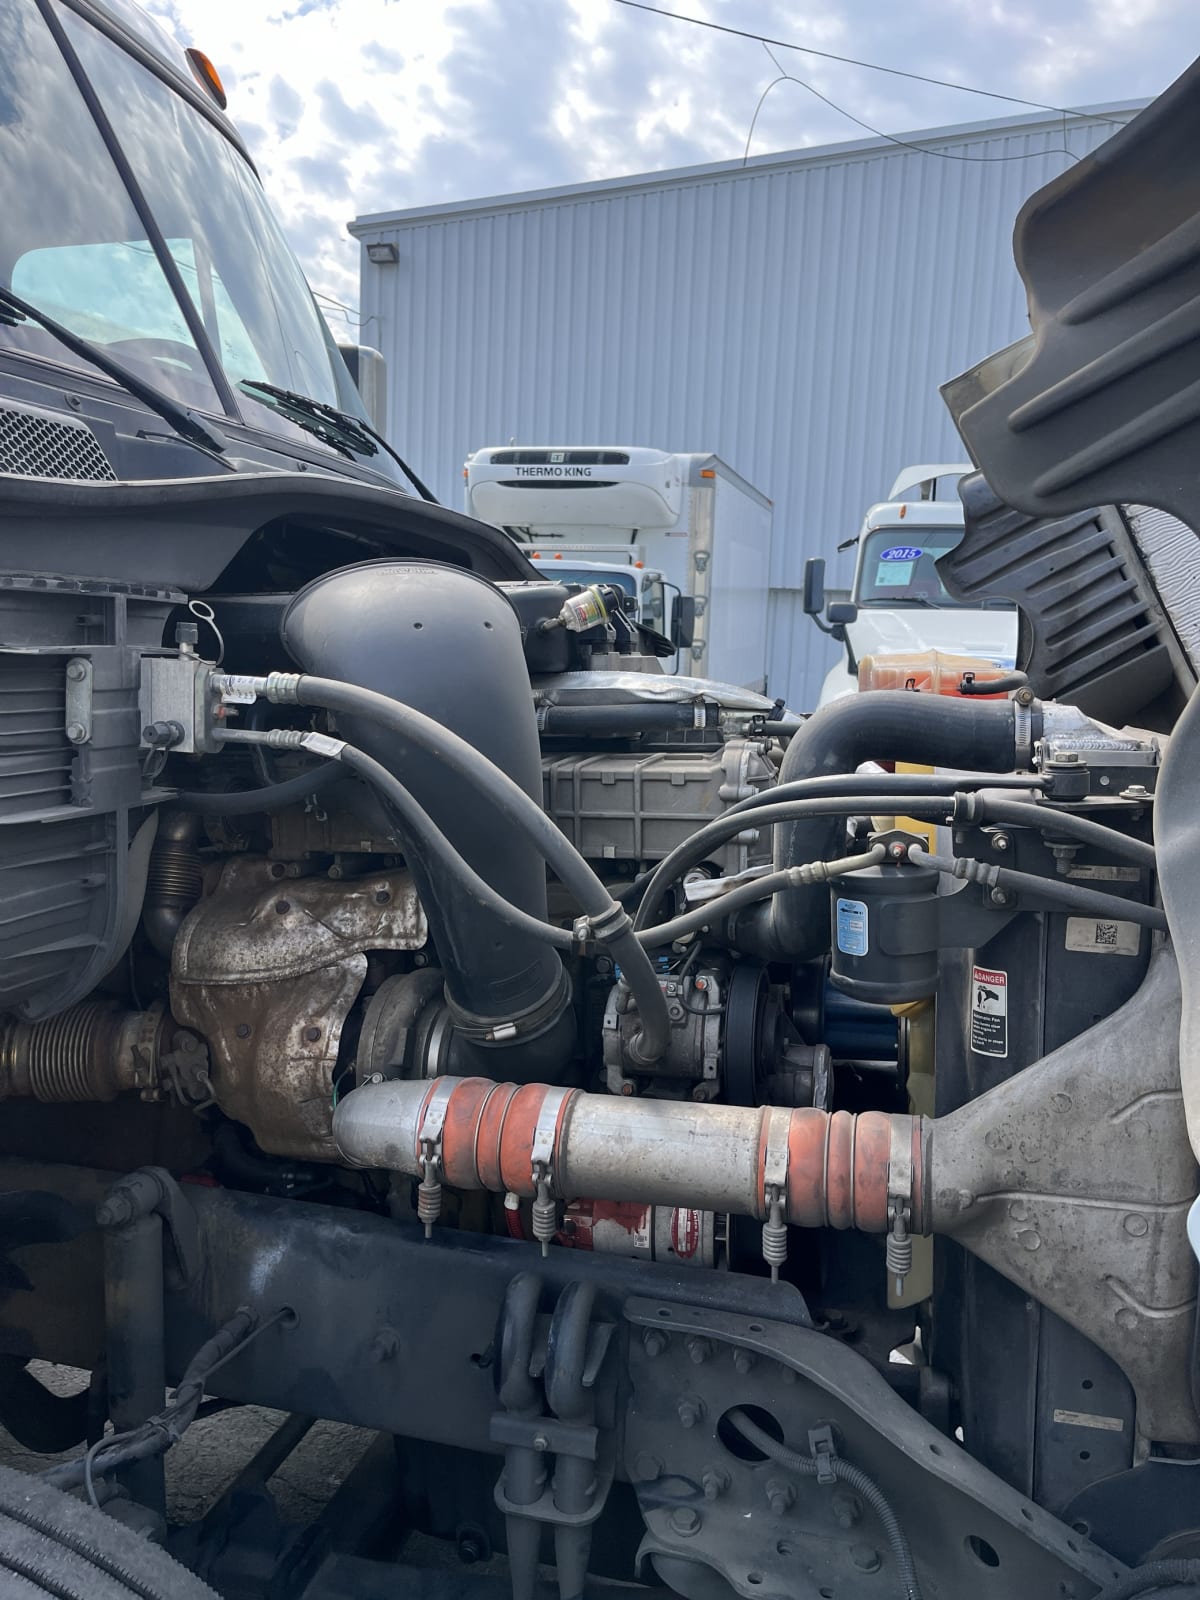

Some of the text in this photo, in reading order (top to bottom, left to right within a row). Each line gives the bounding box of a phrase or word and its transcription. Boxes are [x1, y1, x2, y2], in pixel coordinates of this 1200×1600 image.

[515, 467, 592, 477] THERMO KING
[887, 549, 917, 559] 2015
[977, 973, 1005, 985] DANGER
